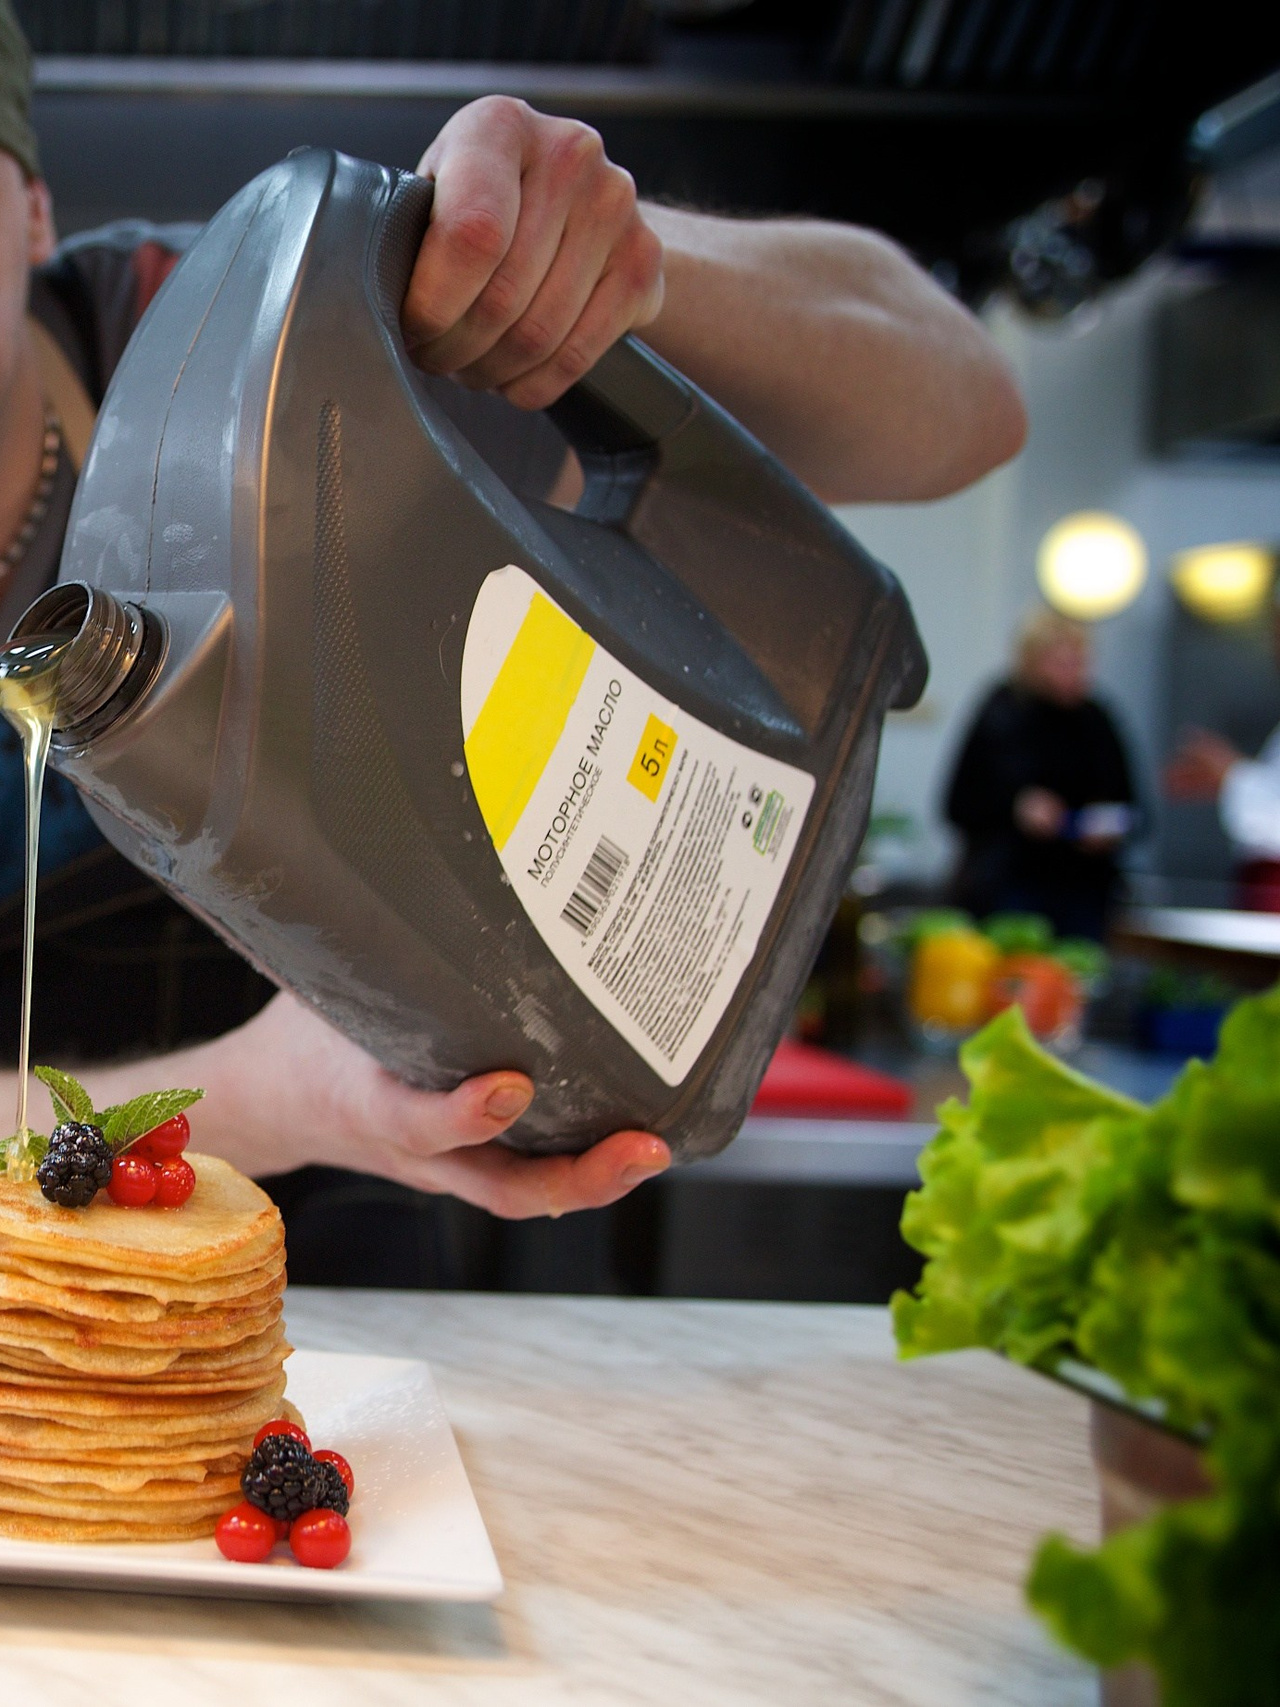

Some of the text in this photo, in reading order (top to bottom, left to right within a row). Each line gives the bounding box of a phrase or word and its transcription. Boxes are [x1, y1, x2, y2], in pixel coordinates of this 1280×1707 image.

[527, 679, 622, 880] МОТОРНОЕ МАСЛО
[641, 753, 661, 777] 5
[540, 767, 603, 888] ПОЛУСИНТЕТИЧЕСКОЕ
